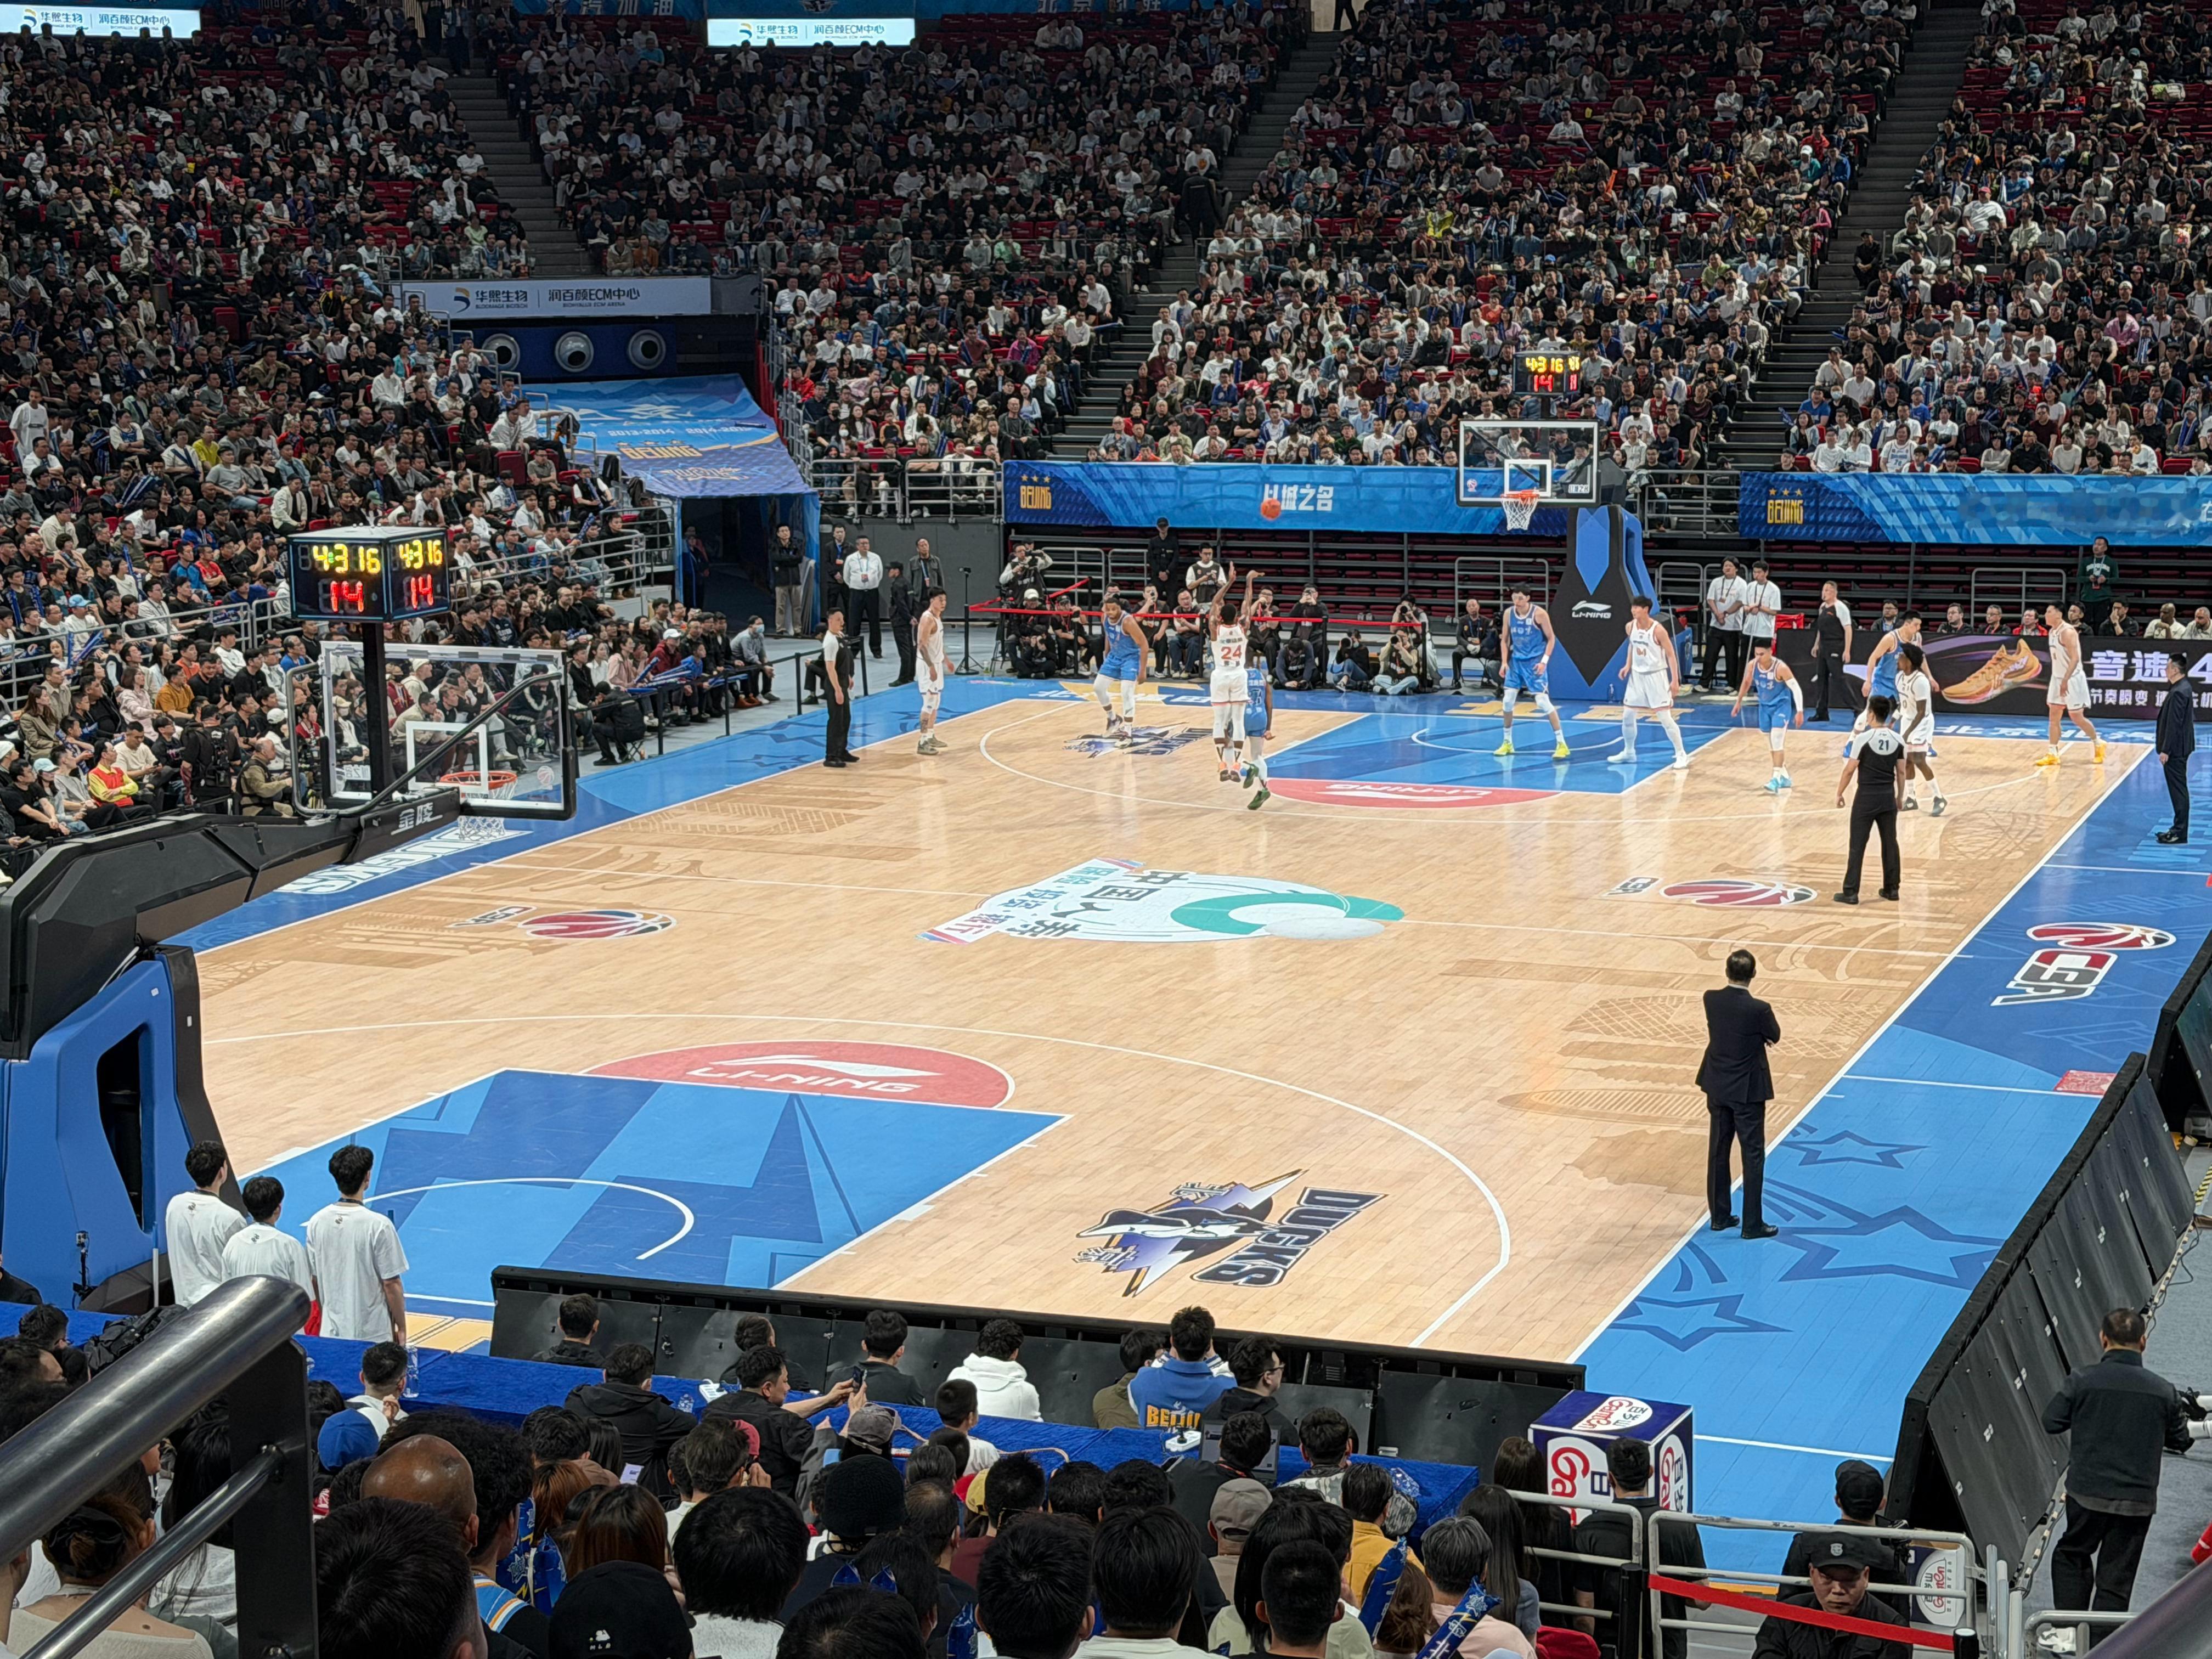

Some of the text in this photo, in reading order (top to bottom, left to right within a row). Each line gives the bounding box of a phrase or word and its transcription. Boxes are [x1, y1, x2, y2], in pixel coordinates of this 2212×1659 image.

[756, 25, 798, 35] 华熙生物
[475, 289, 528, 303] 华熙生物
[549, 287, 641, 302] 润百颜ECM中心
[1534, 374, 1553, 392] 14
[616, 445, 703, 459] BEIJING
[1020, 485, 1052, 509] BEIJING
[1767, 500, 1803, 524] BEIJING
[330, 580, 364, 613] 14
[410, 573, 434, 610] 14
[1221, 644, 1242, 660] 24
[1878, 739, 1889, 751] 21
[391, 802, 443, 835] 金陵
[1007, 871, 1189, 938] 中国人寿
[1990, 948, 2118, 1006] CBA
[686, 1067, 922, 1092] LI-NING
[1189, 1186, 1389, 1287] DUCKS
